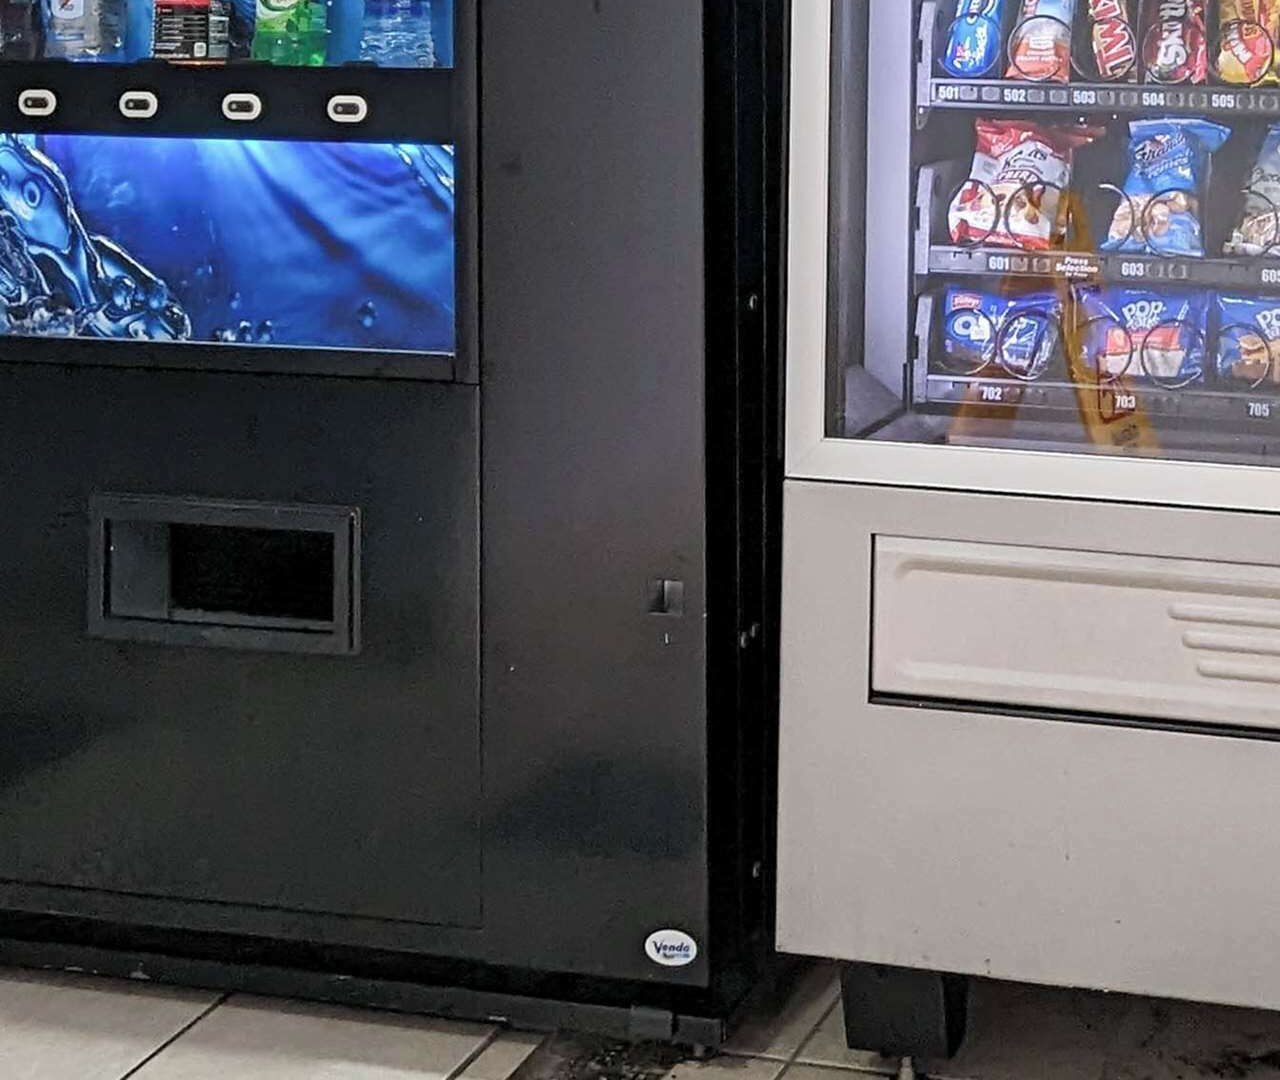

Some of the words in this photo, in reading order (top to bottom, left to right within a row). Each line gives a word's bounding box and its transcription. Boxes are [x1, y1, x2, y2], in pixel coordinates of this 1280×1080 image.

[938, 87, 959, 99] 501
[1004, 89, 1026, 102] 502
[1073, 91, 1096, 104] 503
[1142, 93, 1165, 106] 504
[1212, 95, 1235, 108] 505
[988, 256, 1009, 270] 601
[1121, 262, 1144, 275] 603
[982, 386, 1002, 400] 702
[1114, 394, 1136, 408] 703
[1248, 402, 1270, 417] 705
[652, 940, 690, 954] Vendo
